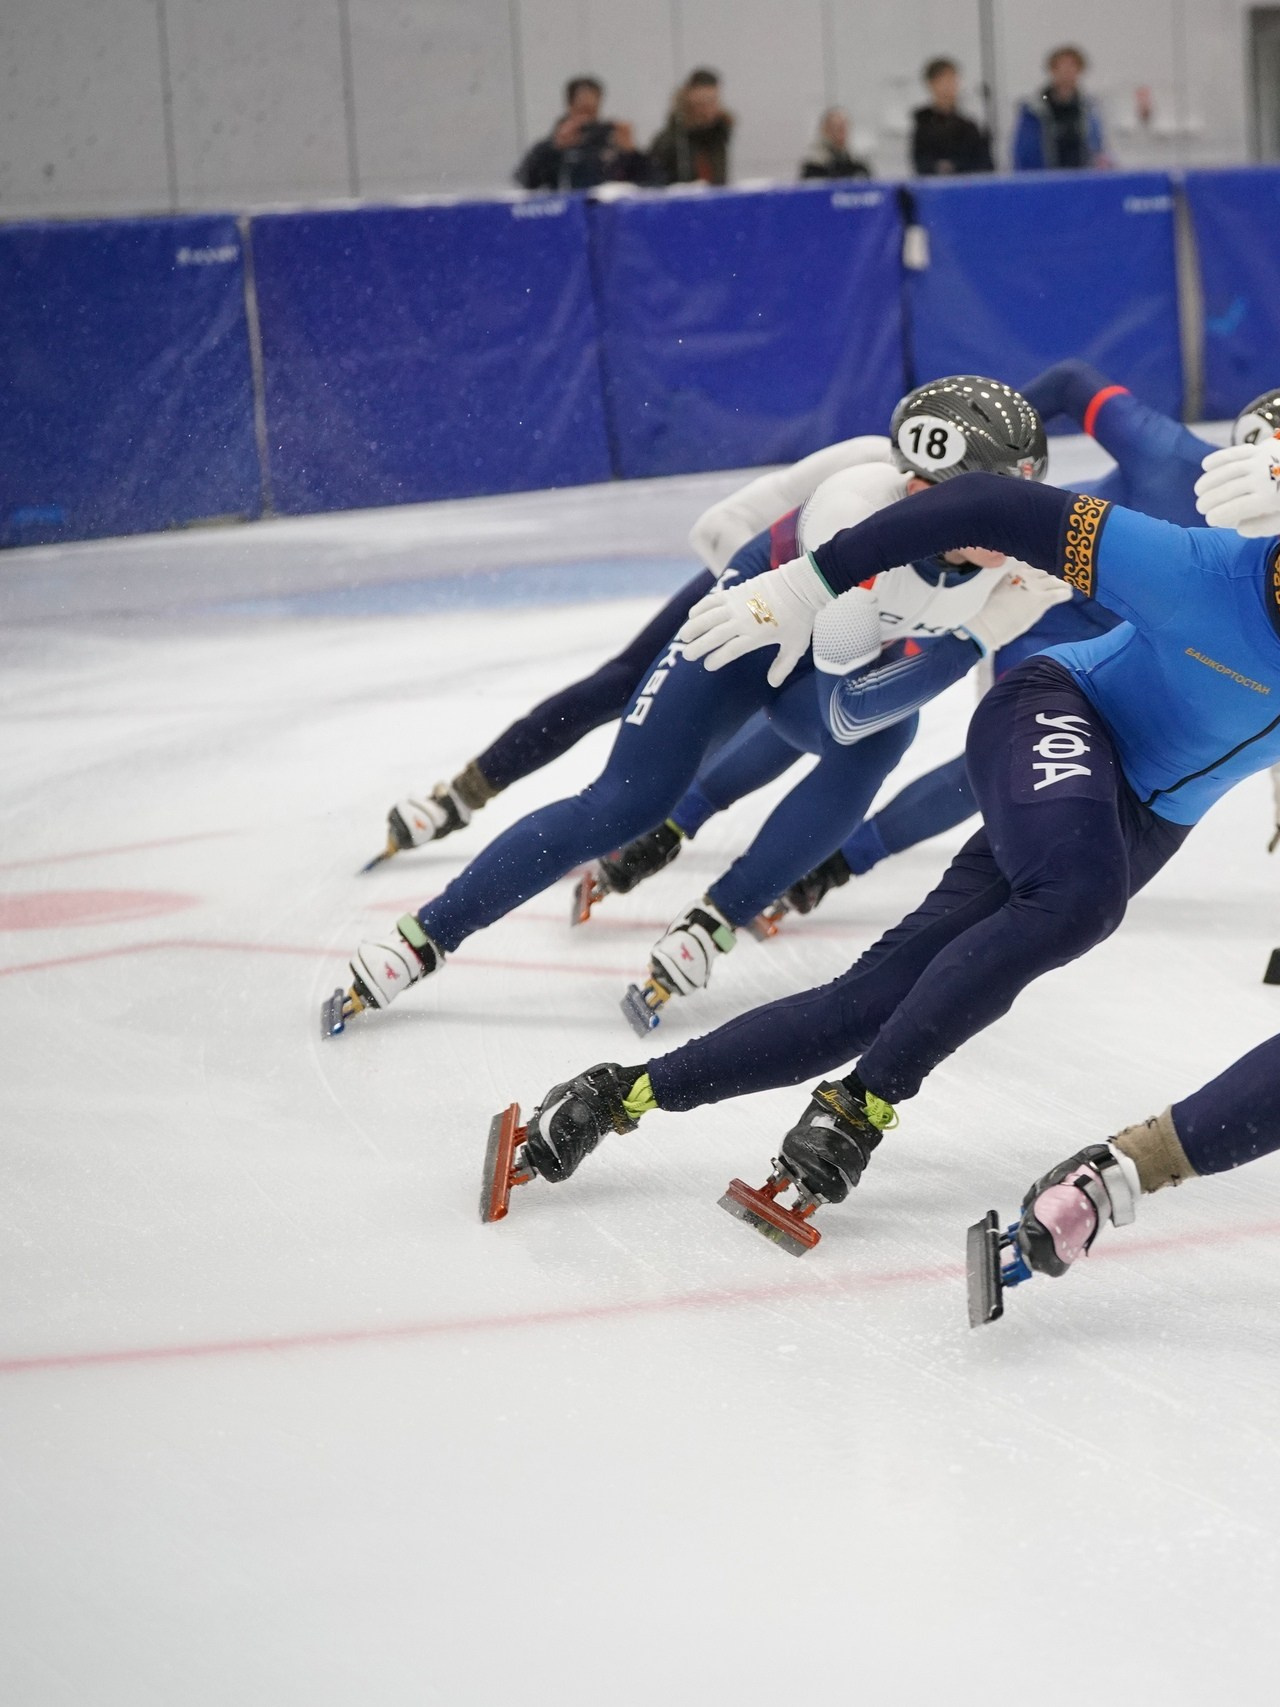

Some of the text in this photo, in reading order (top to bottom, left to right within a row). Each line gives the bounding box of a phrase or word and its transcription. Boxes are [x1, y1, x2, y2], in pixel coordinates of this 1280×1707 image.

[909, 423, 949, 460] 18
[1184, 647, 1271, 695] БАШКОРТОСТАН
[1032, 712, 1092, 791] УФА
